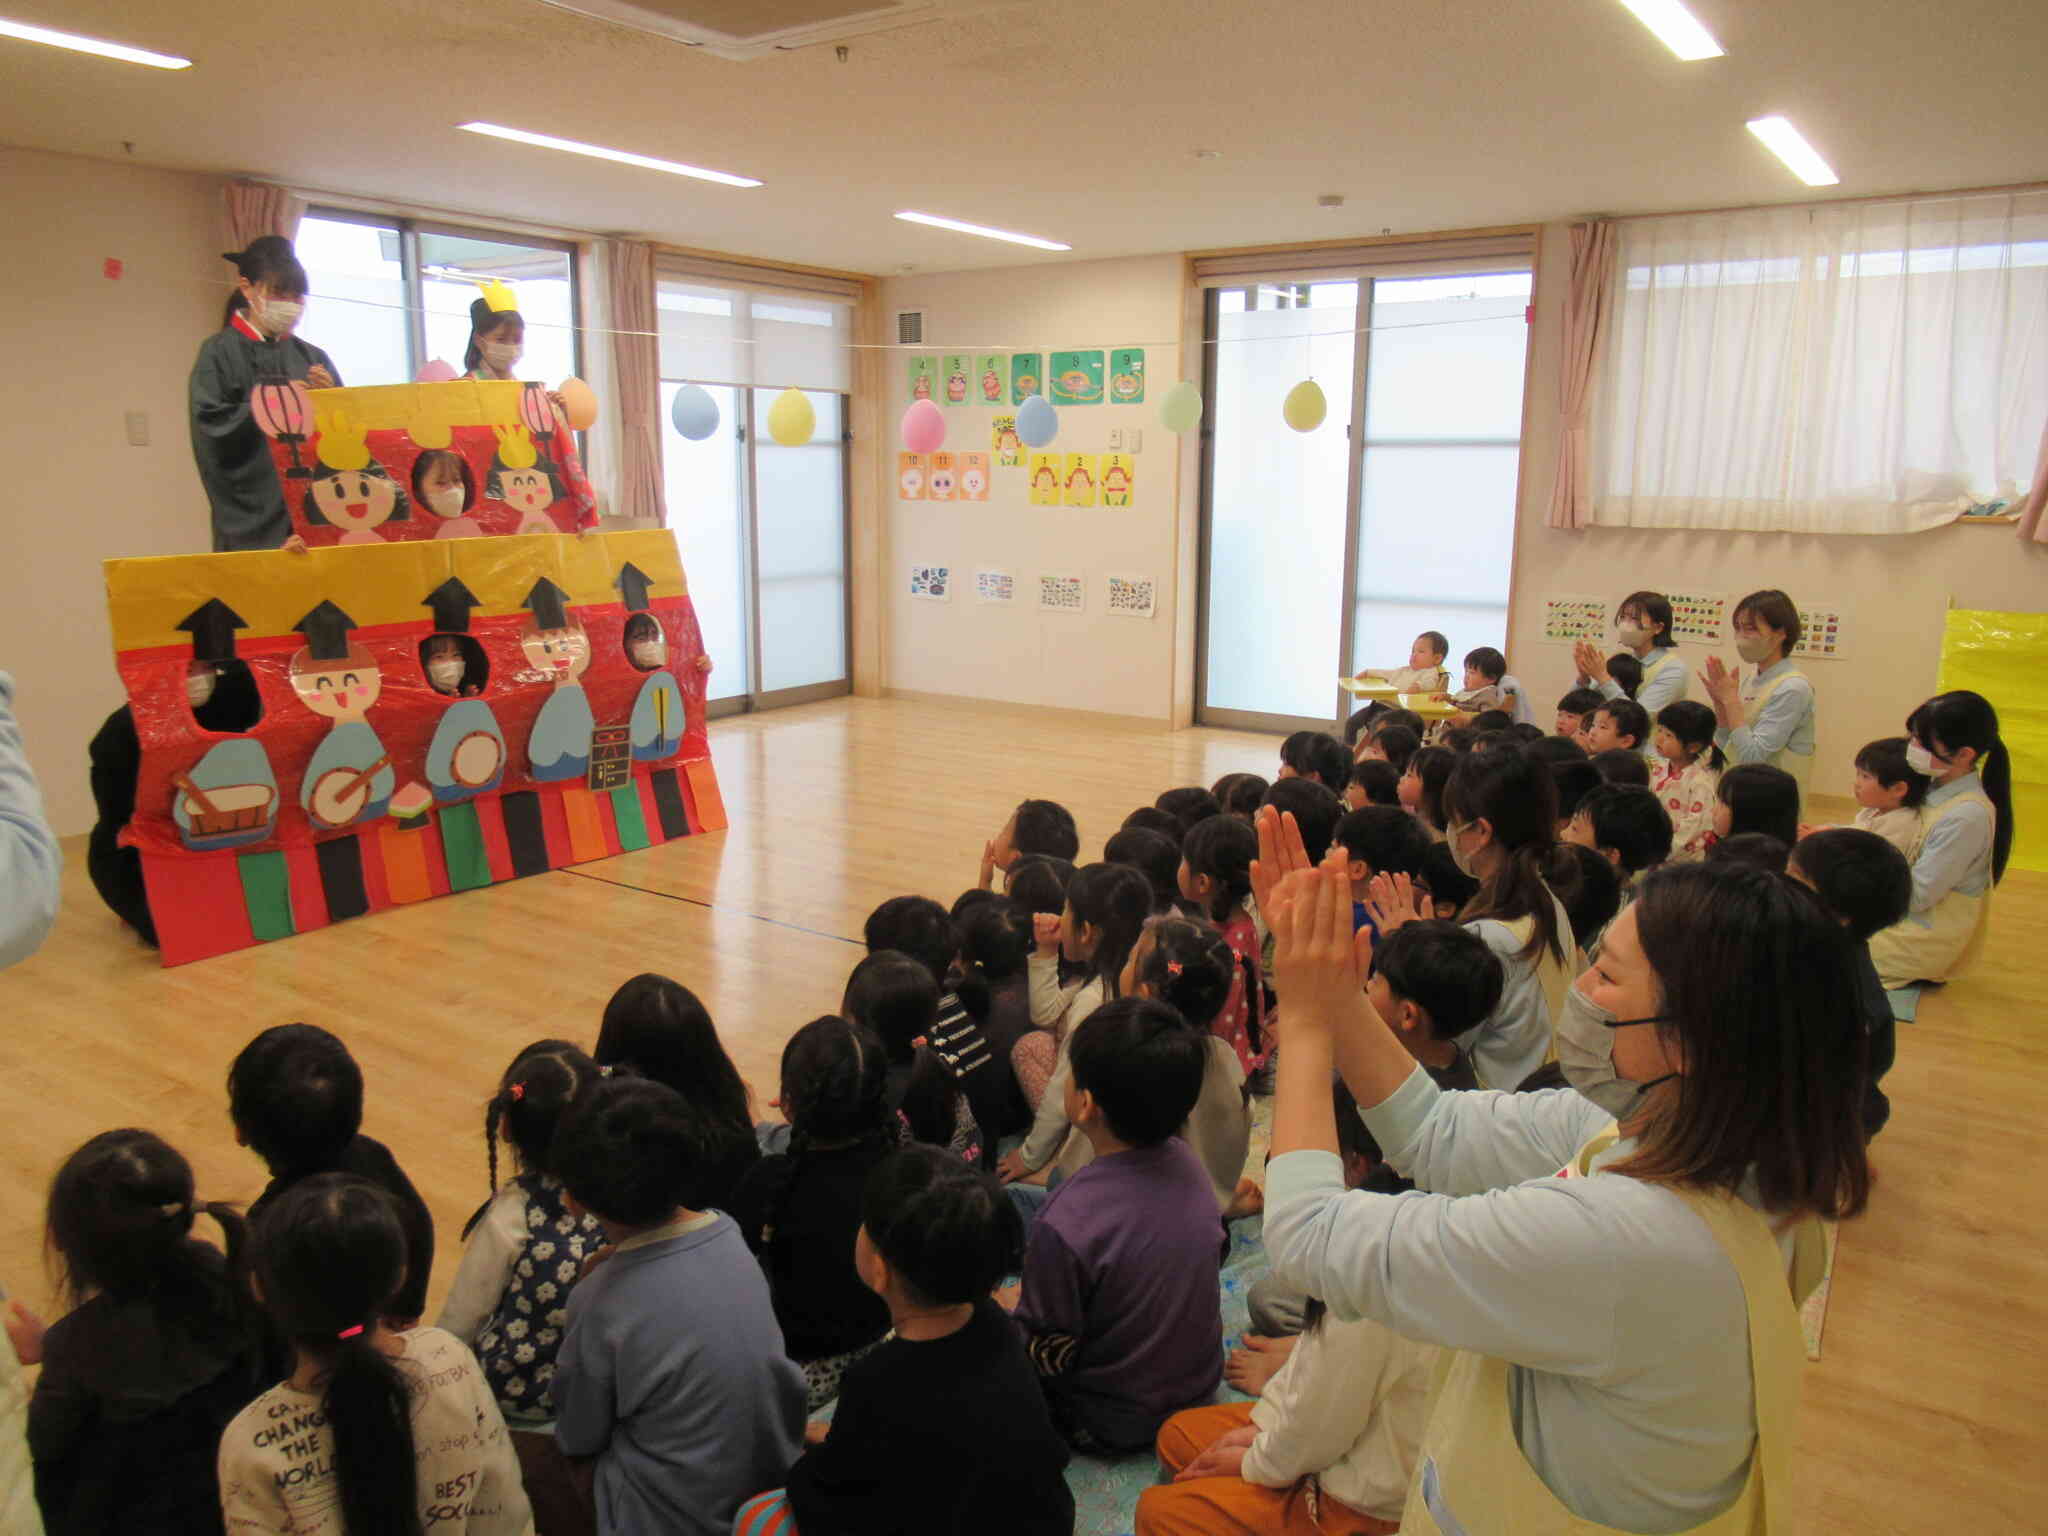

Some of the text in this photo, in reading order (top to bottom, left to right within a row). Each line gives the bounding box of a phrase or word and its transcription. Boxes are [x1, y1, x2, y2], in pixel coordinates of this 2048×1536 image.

[253, 1411, 332, 1448] CHANG
[279, 1432, 321, 1462] THE
[434, 1469, 479, 1499] BEST
